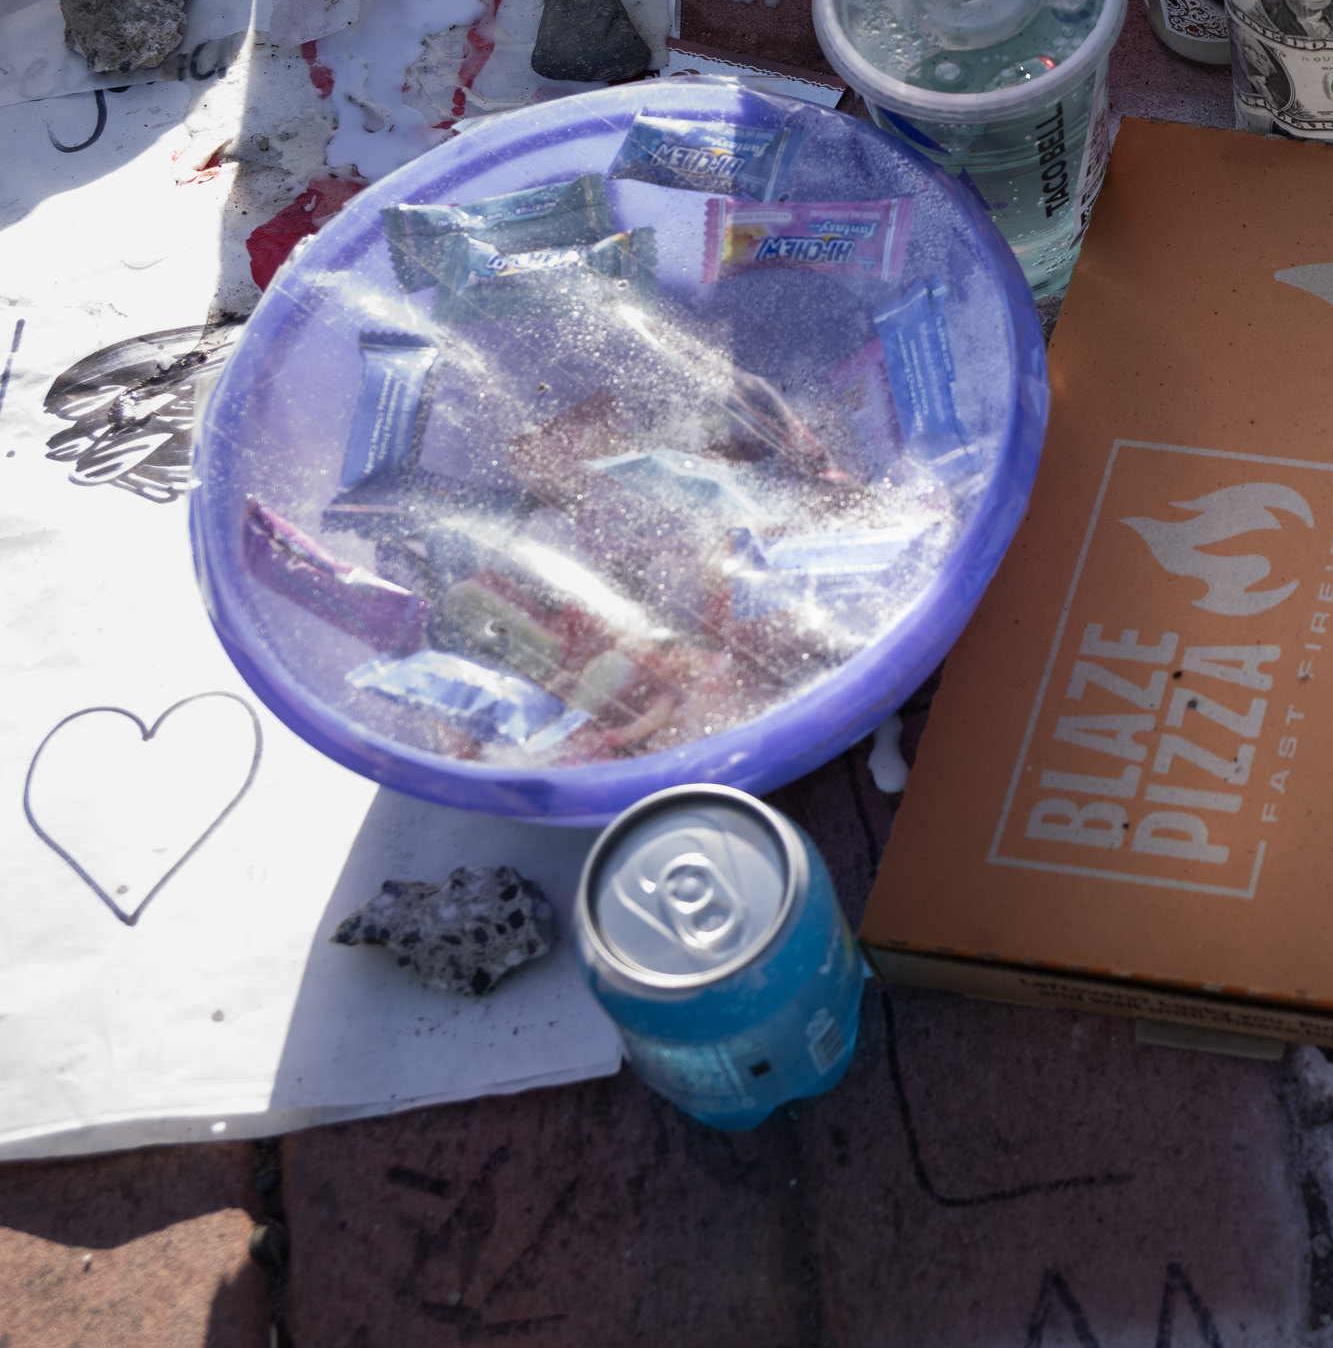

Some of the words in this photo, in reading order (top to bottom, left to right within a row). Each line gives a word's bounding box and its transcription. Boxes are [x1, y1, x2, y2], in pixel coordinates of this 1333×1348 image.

[651, 143, 745, 178] HI-CHEW
[757, 236, 856, 264] HI-CHEW
[1024, 623, 1179, 849] BLAZE
[1130, 644, 1282, 864] PIZZA
[1262, 705, 1305, 824] FAST
